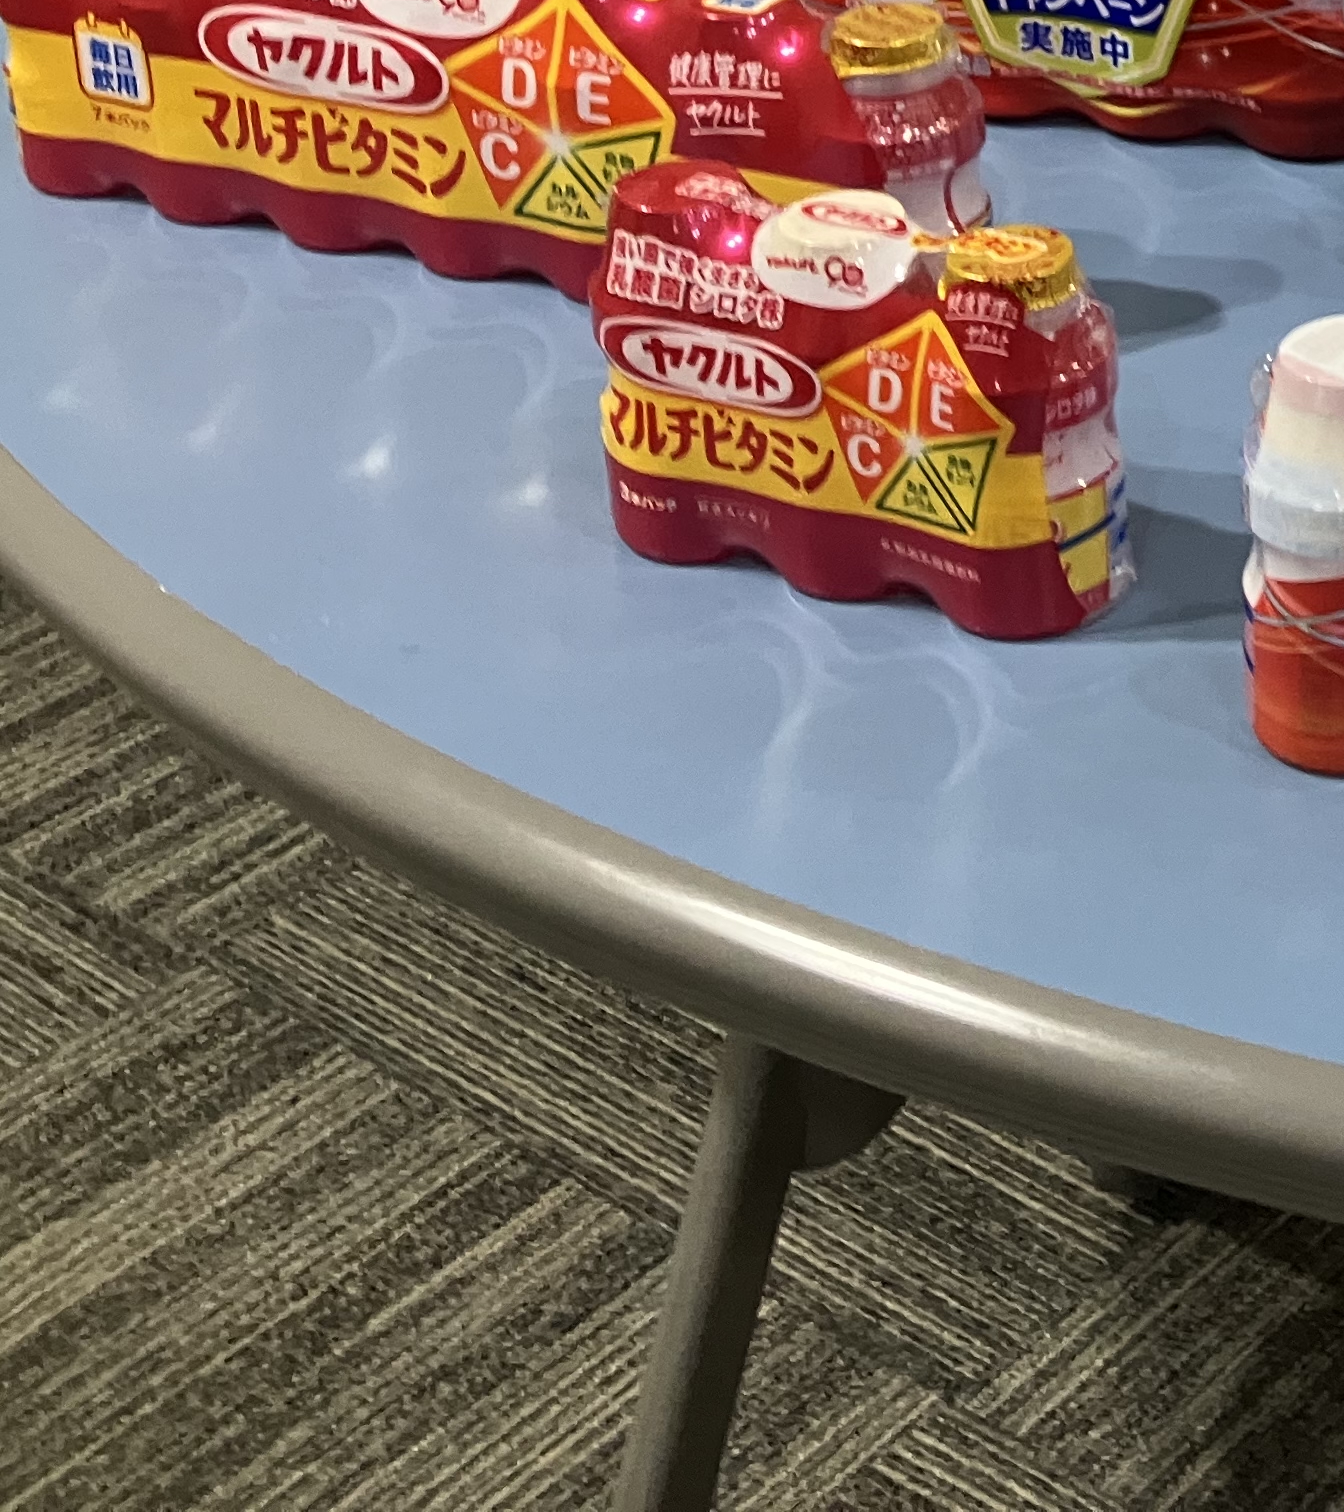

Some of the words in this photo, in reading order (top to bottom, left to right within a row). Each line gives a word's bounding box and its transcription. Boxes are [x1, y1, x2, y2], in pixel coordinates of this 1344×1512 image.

[246, 25, 399, 92] ヤクルト
[1020, 20, 1132, 69] 実施中
[502, 57, 537, 109] D
[576, 71, 612, 127] E
[687, 100, 762, 130] ヤクルト
[194, 89, 467, 197] マルチビタミン
[478, 129, 521, 181] C
[641, 337, 780, 395] ヤクルト
[867, 367, 903, 414] D
[930, 383, 956, 432] E
[608, 388, 835, 494] マルチビタミン
[847, 434, 882, 479] C
